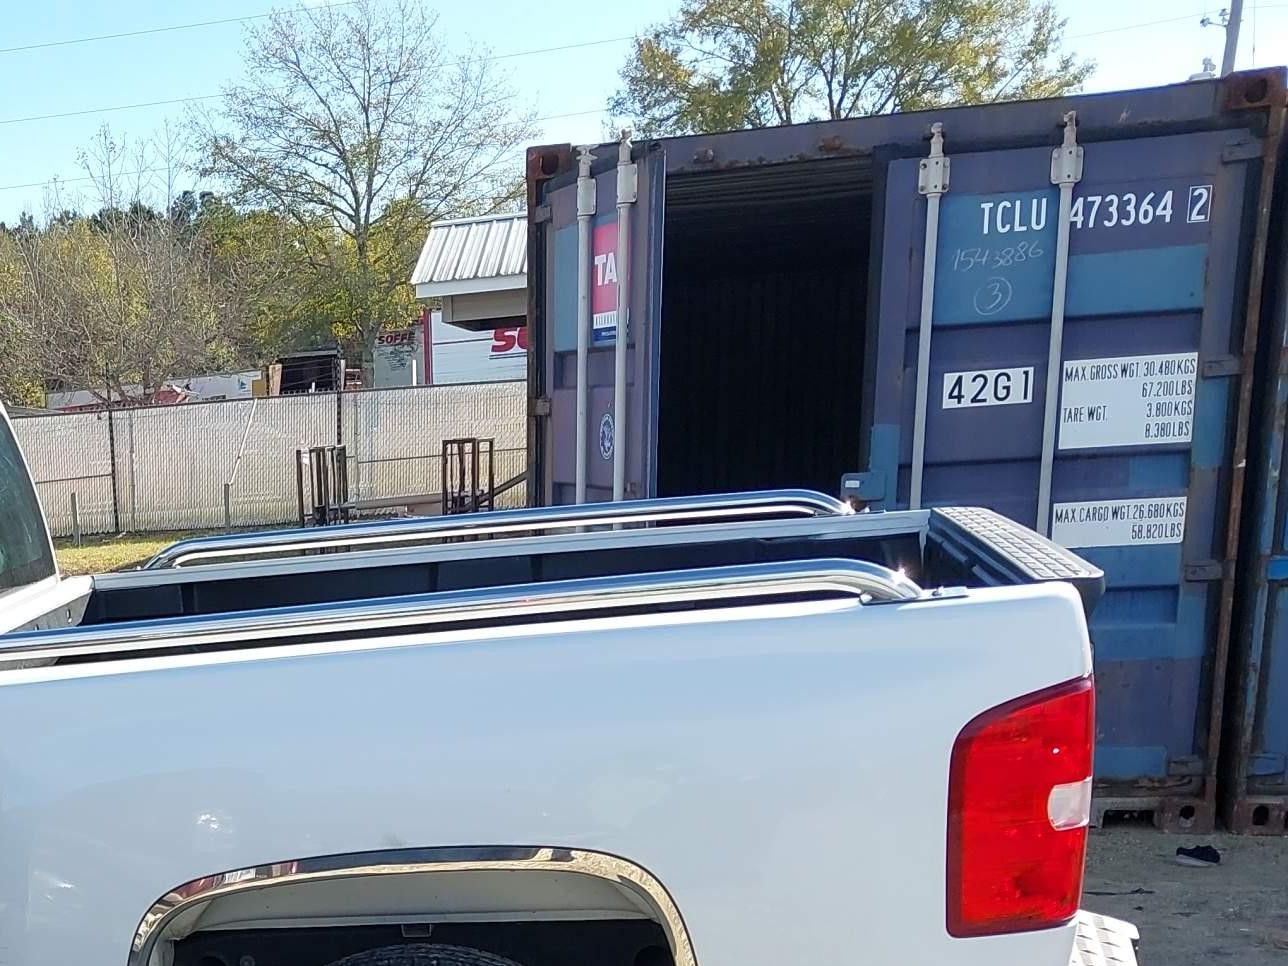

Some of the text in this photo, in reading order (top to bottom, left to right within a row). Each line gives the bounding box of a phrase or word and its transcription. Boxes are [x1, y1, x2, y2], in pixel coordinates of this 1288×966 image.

[980, 188, 1208, 234] TCLU 473364 2
[594, 252, 618, 286] TA
[948, 370, 1030, 404] 42G1
[1063, 406, 1085, 423] TARE
[1079, 506, 1109, 522] CARGO
